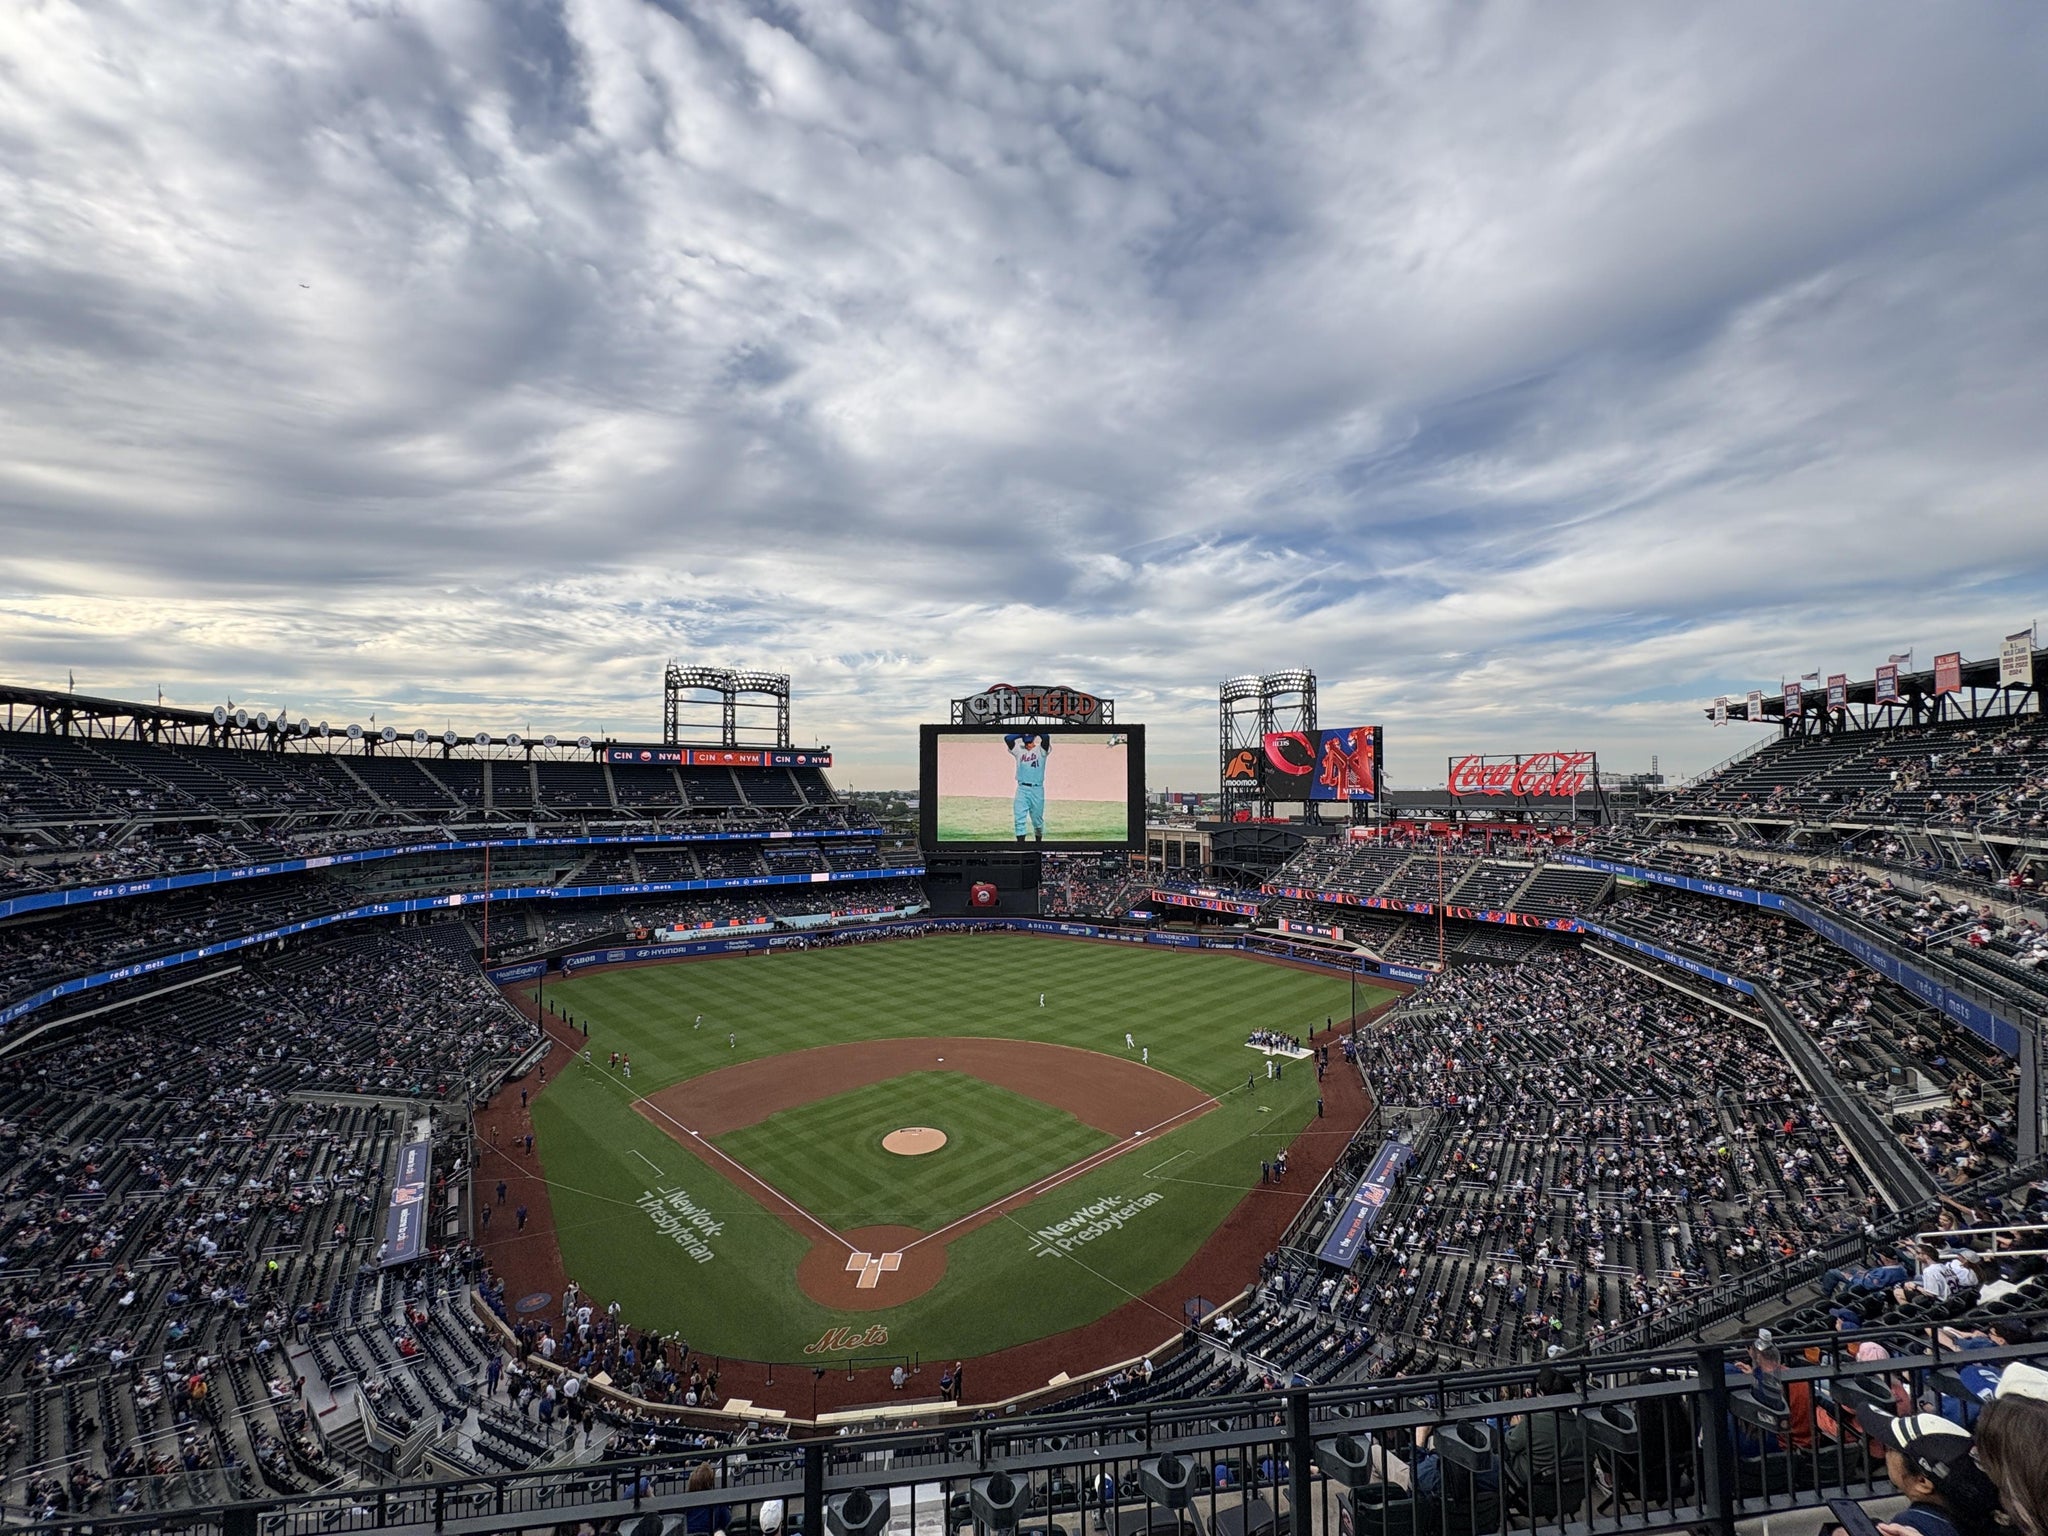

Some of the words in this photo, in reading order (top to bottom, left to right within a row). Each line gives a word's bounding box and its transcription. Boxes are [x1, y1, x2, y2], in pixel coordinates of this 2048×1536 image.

[1024, 694, 1097, 715] FIELD
[614, 752, 632, 760] CIN
[659, 752, 681, 761] NYM
[811, 756, 830, 764] NYM
[1031, 760, 1039, 768] 41
[1342, 787, 1365, 795] METS
[1182, 804, 1188, 814] 8
[93, 888, 113, 897] reds
[130, 883, 150, 891] mets
[1702, 884, 1716, 892] reds
[1727, 889, 1742, 897] mets
[1034, 922, 1053, 930] DELTA
[1317, 927, 1332, 936] NYM
[241, 936, 255, 945] reds
[264, 930, 278, 938] mets
[651, 947, 687, 956] HYUNDAI
[567, 955, 596, 966] Canon
[1665, 953, 1677, 963] reds
[1685, 961, 1699, 972] mets
[110, 969, 129, 980] reds
[145, 960, 164, 970] mets
[496, 965, 538, 979] HealthEquity
[1389, 967, 1423, 980] Heineken
[1949, 999, 1970, 1020] mets
[664, 1190, 725, 1236] NewYork-
[1037, 1195, 1121, 1241] NewYork-
[1055, 1191, 1164, 1252] Presbyterian
[640, 1199, 715, 1264] Presbyterian
[803, 1324, 889, 1354] Mets
